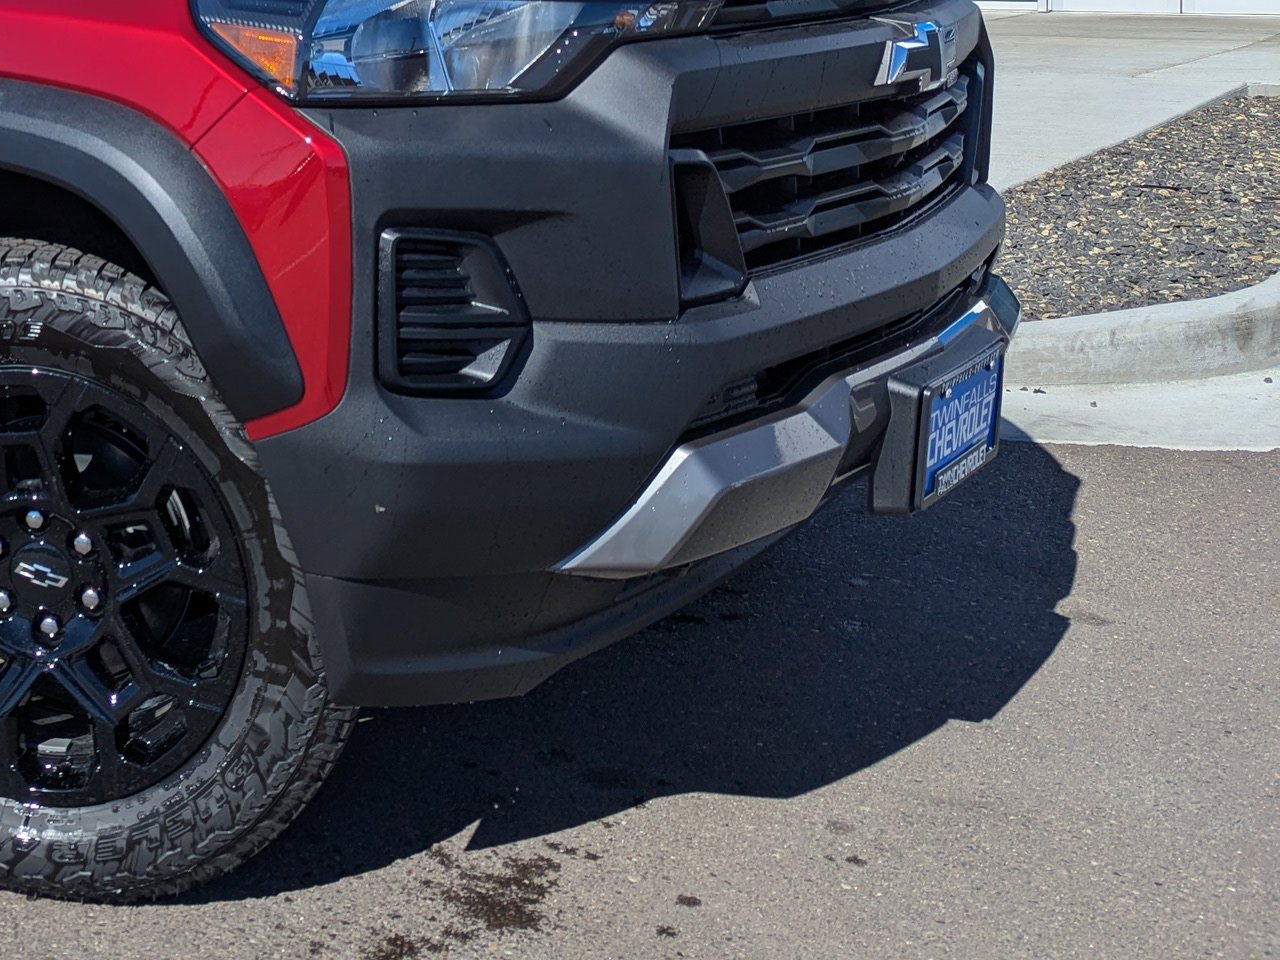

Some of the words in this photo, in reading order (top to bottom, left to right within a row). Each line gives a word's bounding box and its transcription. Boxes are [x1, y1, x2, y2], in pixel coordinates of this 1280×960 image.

[926, 393, 996, 468] CHEVROLET
[930, 373, 997, 432] TWINFALLS
[952, 444, 987, 484] CHEVROLET
